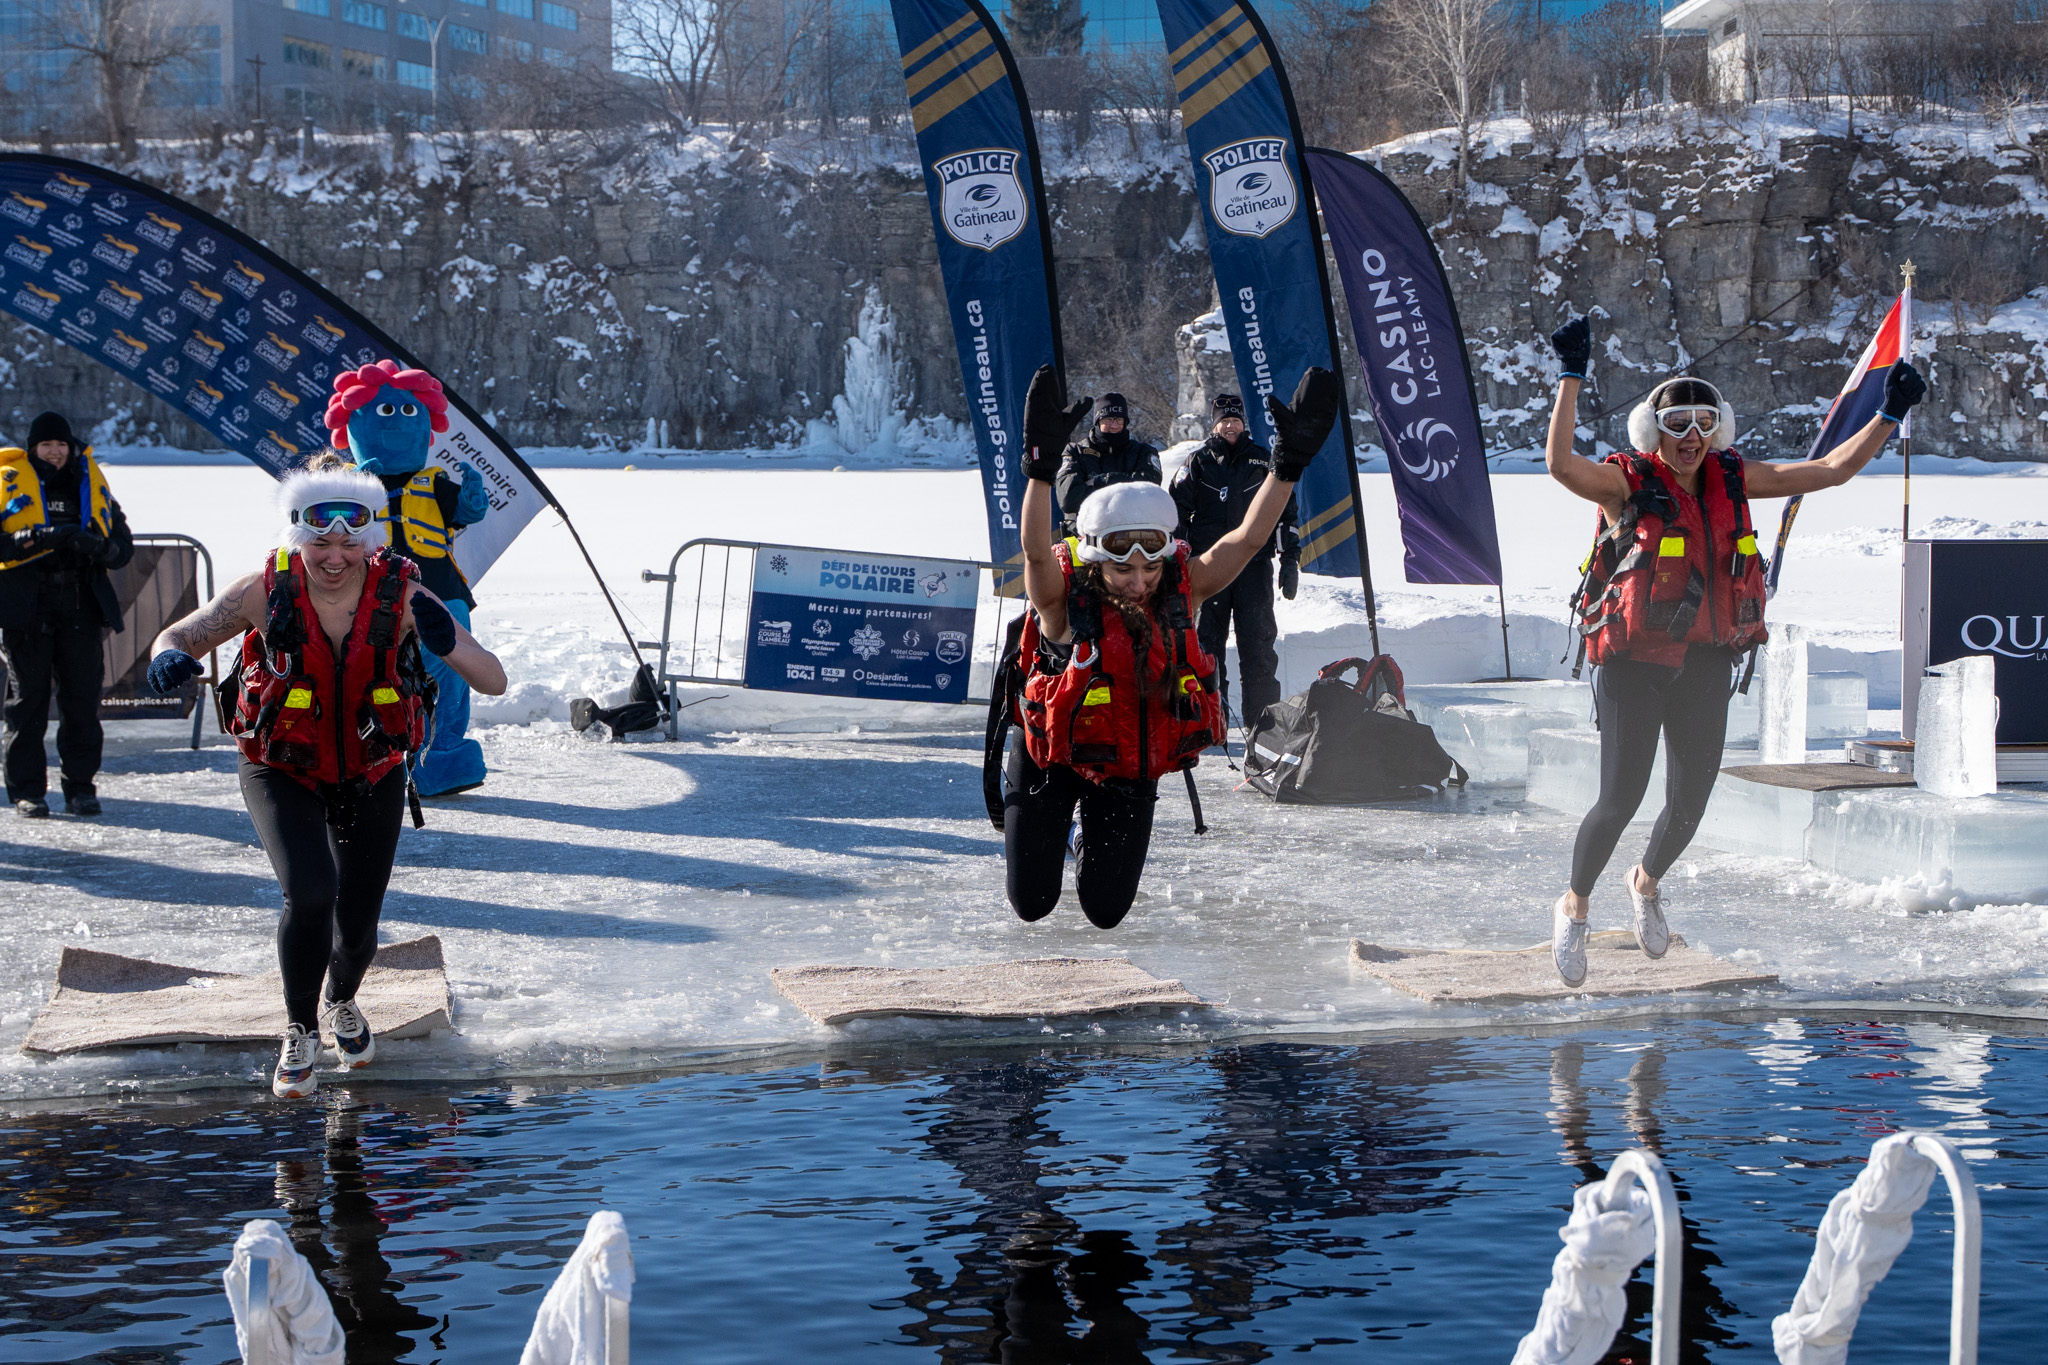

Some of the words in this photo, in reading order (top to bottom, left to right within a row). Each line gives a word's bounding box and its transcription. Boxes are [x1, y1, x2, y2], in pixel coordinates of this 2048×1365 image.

[940, 154, 1012, 181] POLICE
[1210, 143, 1280, 173] POLICE
[1224, 195, 1287, 218] Gatineau
[954, 209, 1016, 228] Gatineau
[1362, 248, 1418, 405] CASINO
[1398, 276, 1442, 398] LAC-LEAMY
[966, 300, 1018, 530] police.gatineau.ca
[450, 431, 518, 498] Partenaire
[821, 560, 850, 572] DÉFI
[852, 564, 869, 574] DE
[872, 565, 916, 577] L'OURS
[819, 572, 915, 594] POLAIRE
[808, 602, 838, 613] Merci
[843, 607, 862, 615] aux
[866, 609, 932, 620] partenaires!
[801, 638, 840, 646] Olympiques
[1960, 614, 2048, 658] QU
[786, 670, 815, 680] 104.1
[866, 672, 908, 682] Desjardins
